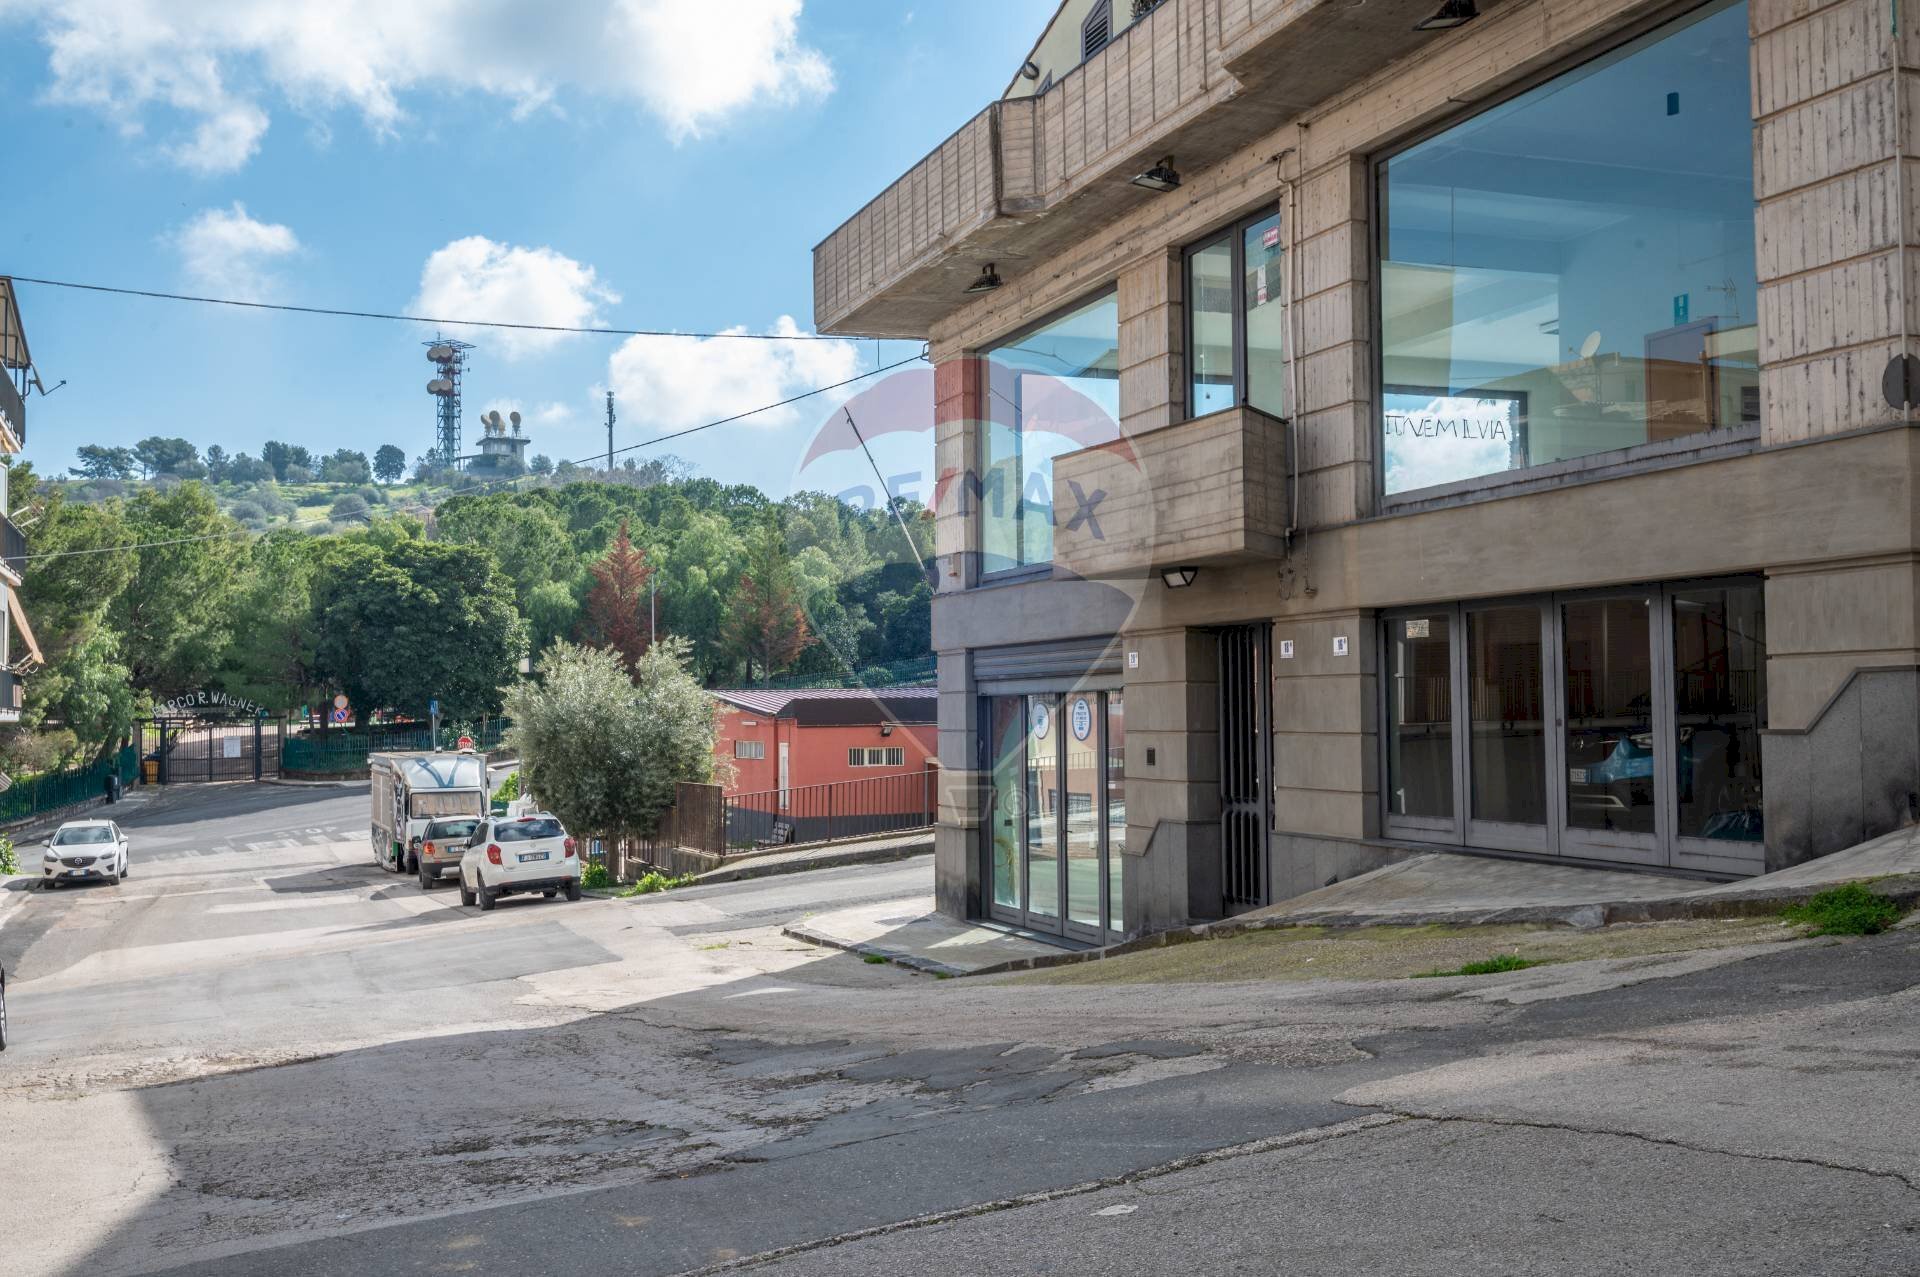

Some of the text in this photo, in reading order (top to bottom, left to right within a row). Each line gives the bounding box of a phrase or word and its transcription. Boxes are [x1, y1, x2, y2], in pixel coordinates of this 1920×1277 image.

[152, 691, 265, 719] PARCO R. WAGNER
[459, 741, 474, 749] STOP
